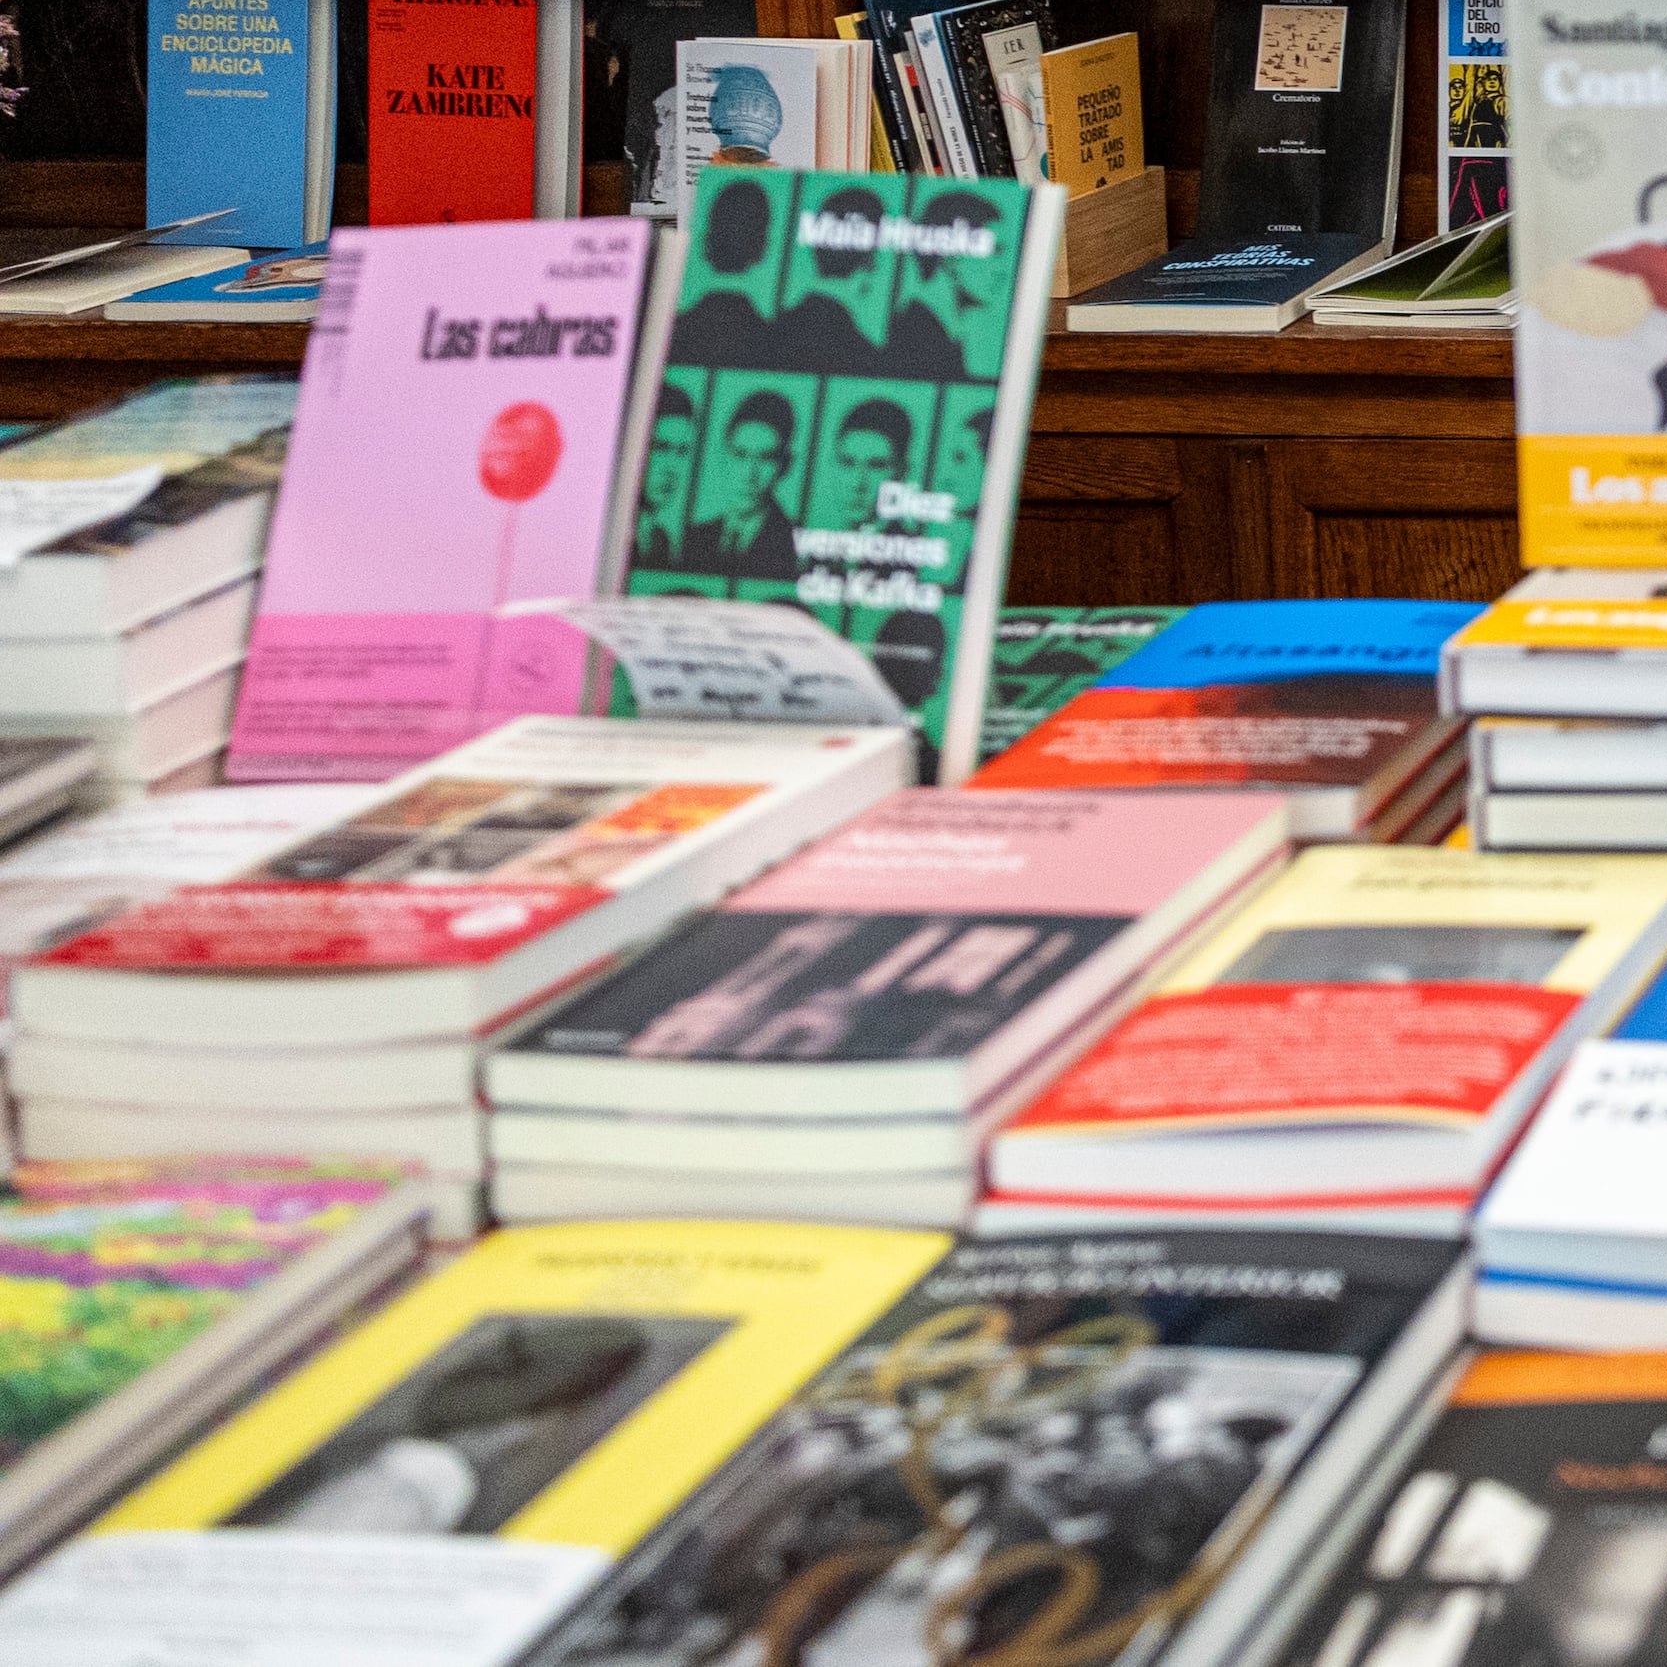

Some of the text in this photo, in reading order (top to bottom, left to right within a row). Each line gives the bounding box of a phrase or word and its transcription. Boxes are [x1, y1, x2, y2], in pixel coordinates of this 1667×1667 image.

[175, 14, 280, 34] SOBRE UNA
[1467, 8, 1488, 20] DEL
[1467, 21, 1500, 34] LIBRO
[161, 35, 292, 55] ENCICLOPEDIA
[191, 51, 264, 77] MÁGICA
[427, 63, 506, 93] KATE
[1077, 85, 1122, 112] PEQUEÑO
[1272, 93, 1321, 104] Crematorio
[1078, 101, 1123, 129] TRATADO
[1080, 139, 1125, 165] LA AMIS
[1106, 154, 1126, 171] TAD
[1162, 256, 1315, 271] CONSPIRATIVAS
[421, 302, 620, 361] Las cabras
[1570, 467, 1643, 504] Los
[878, 482, 954, 523] Diez
[795, 525, 947, 568] versiones
